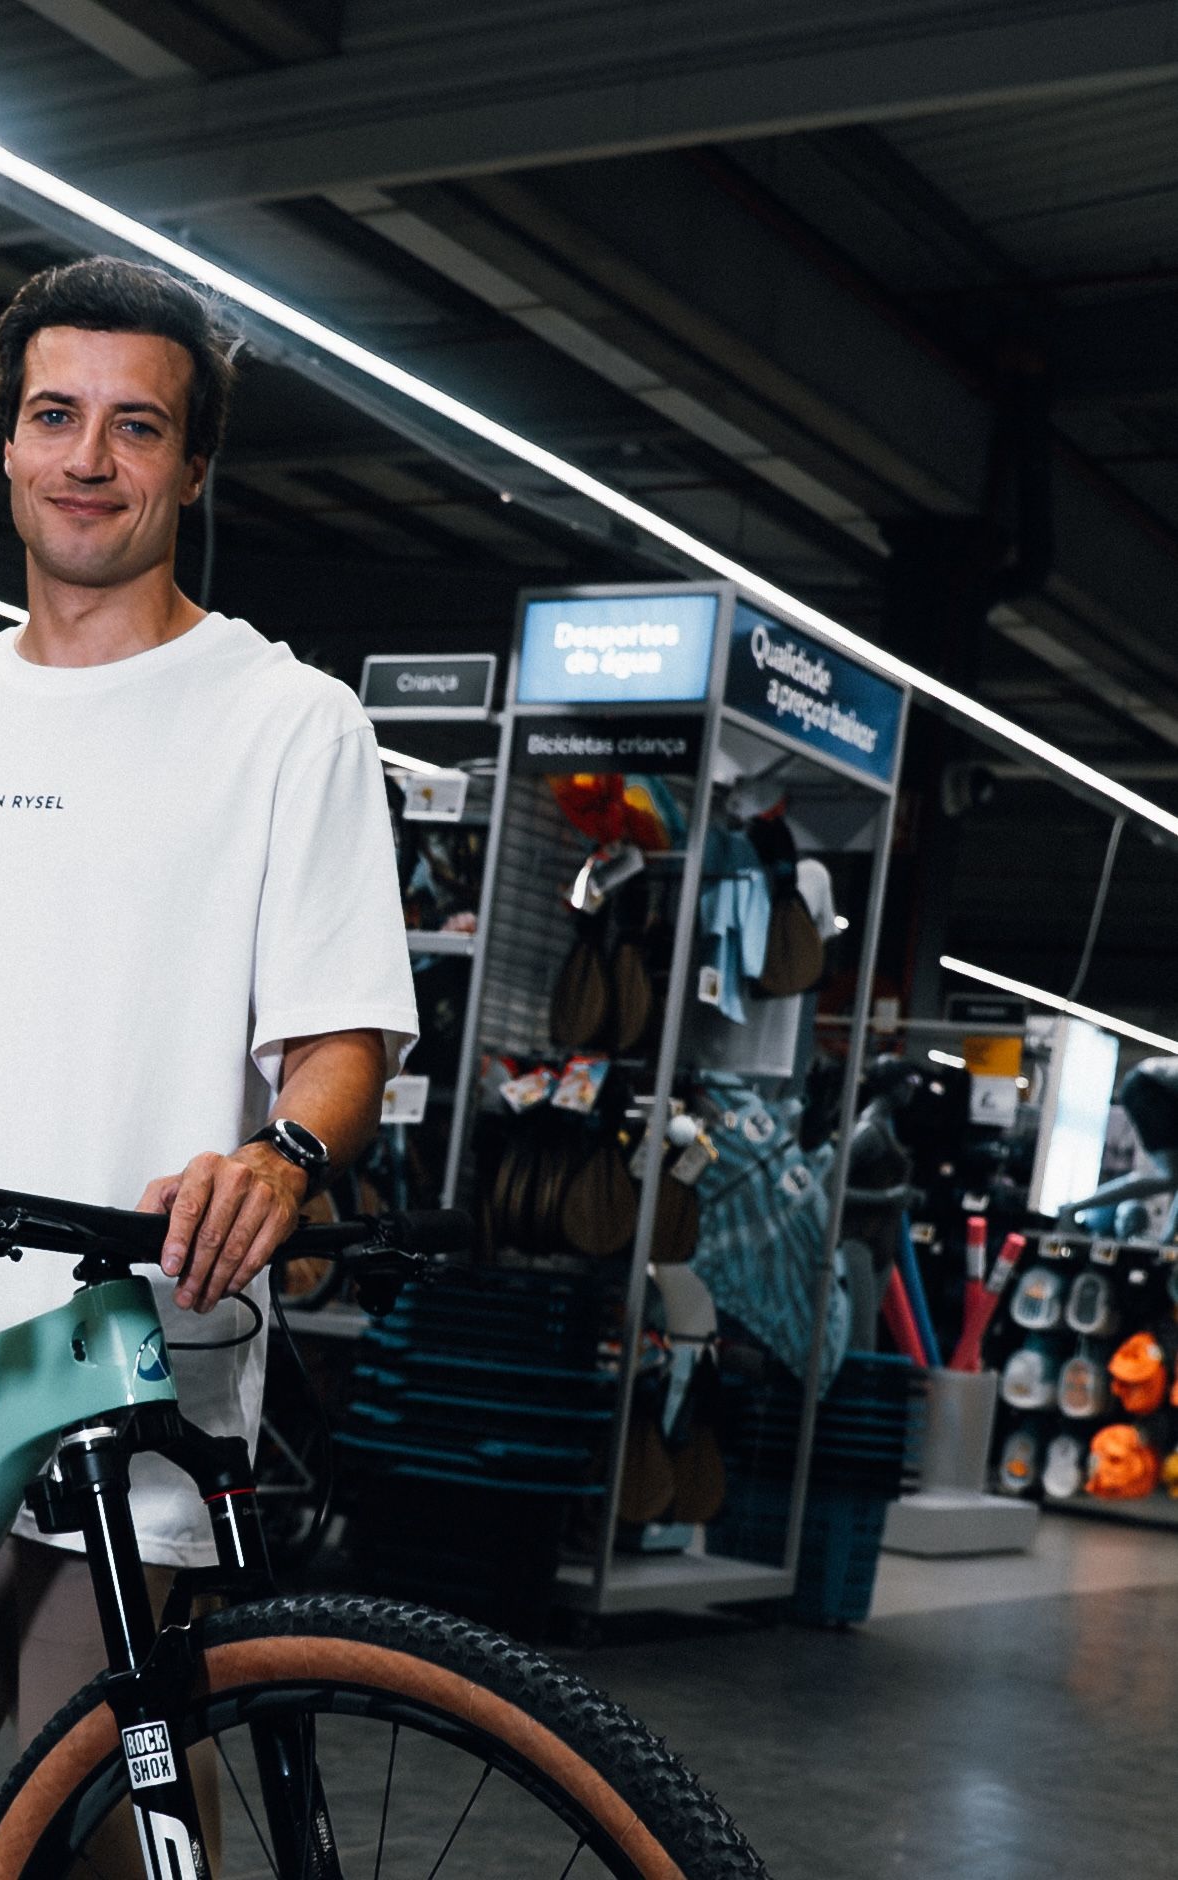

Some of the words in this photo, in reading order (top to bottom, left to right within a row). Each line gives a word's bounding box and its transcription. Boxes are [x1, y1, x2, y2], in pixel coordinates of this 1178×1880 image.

[12, 794, 64, 810] RYSEL
[125, 1726, 167, 1756] ROCK
[131, 1754, 172, 1783] SHOX
